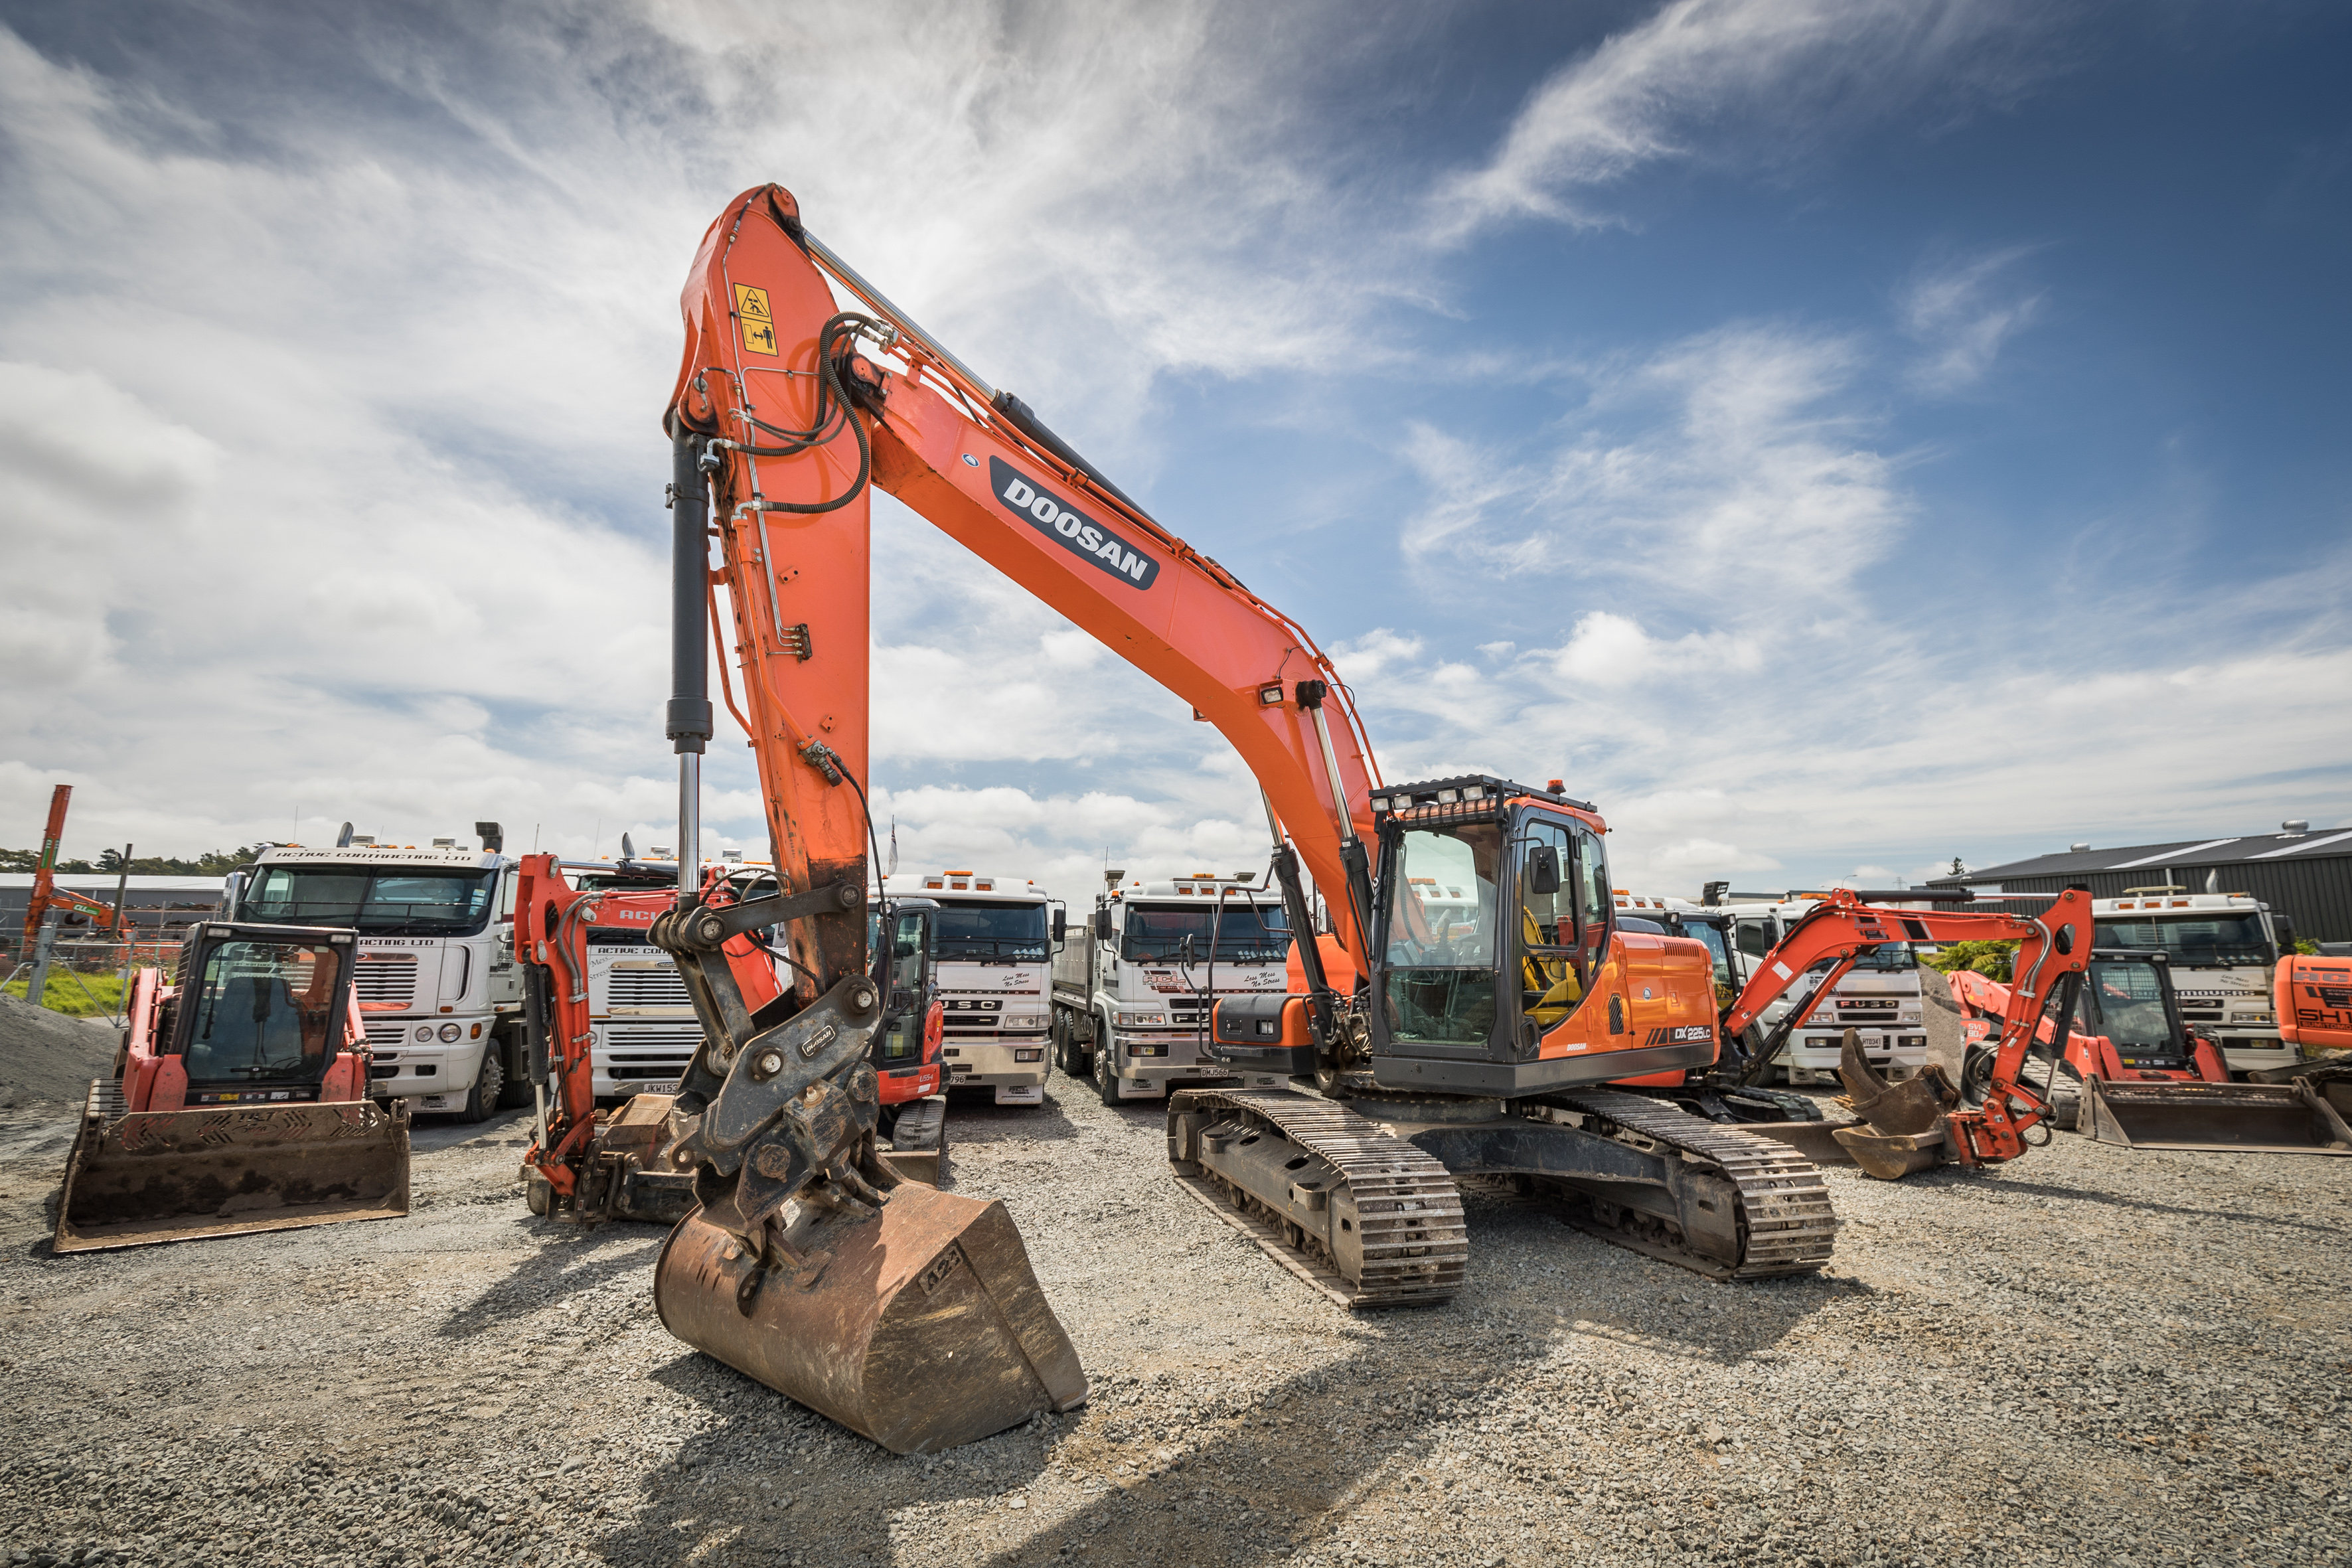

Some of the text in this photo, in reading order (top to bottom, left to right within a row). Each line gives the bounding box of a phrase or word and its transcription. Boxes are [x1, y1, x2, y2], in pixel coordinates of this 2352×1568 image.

[1003, 478, 1148, 581] DOOSAN
[2294, 972, 2352, 982] AC
[645, 1084, 678, 1093] JKW153
[238, 1112, 275, 1123] TILT
